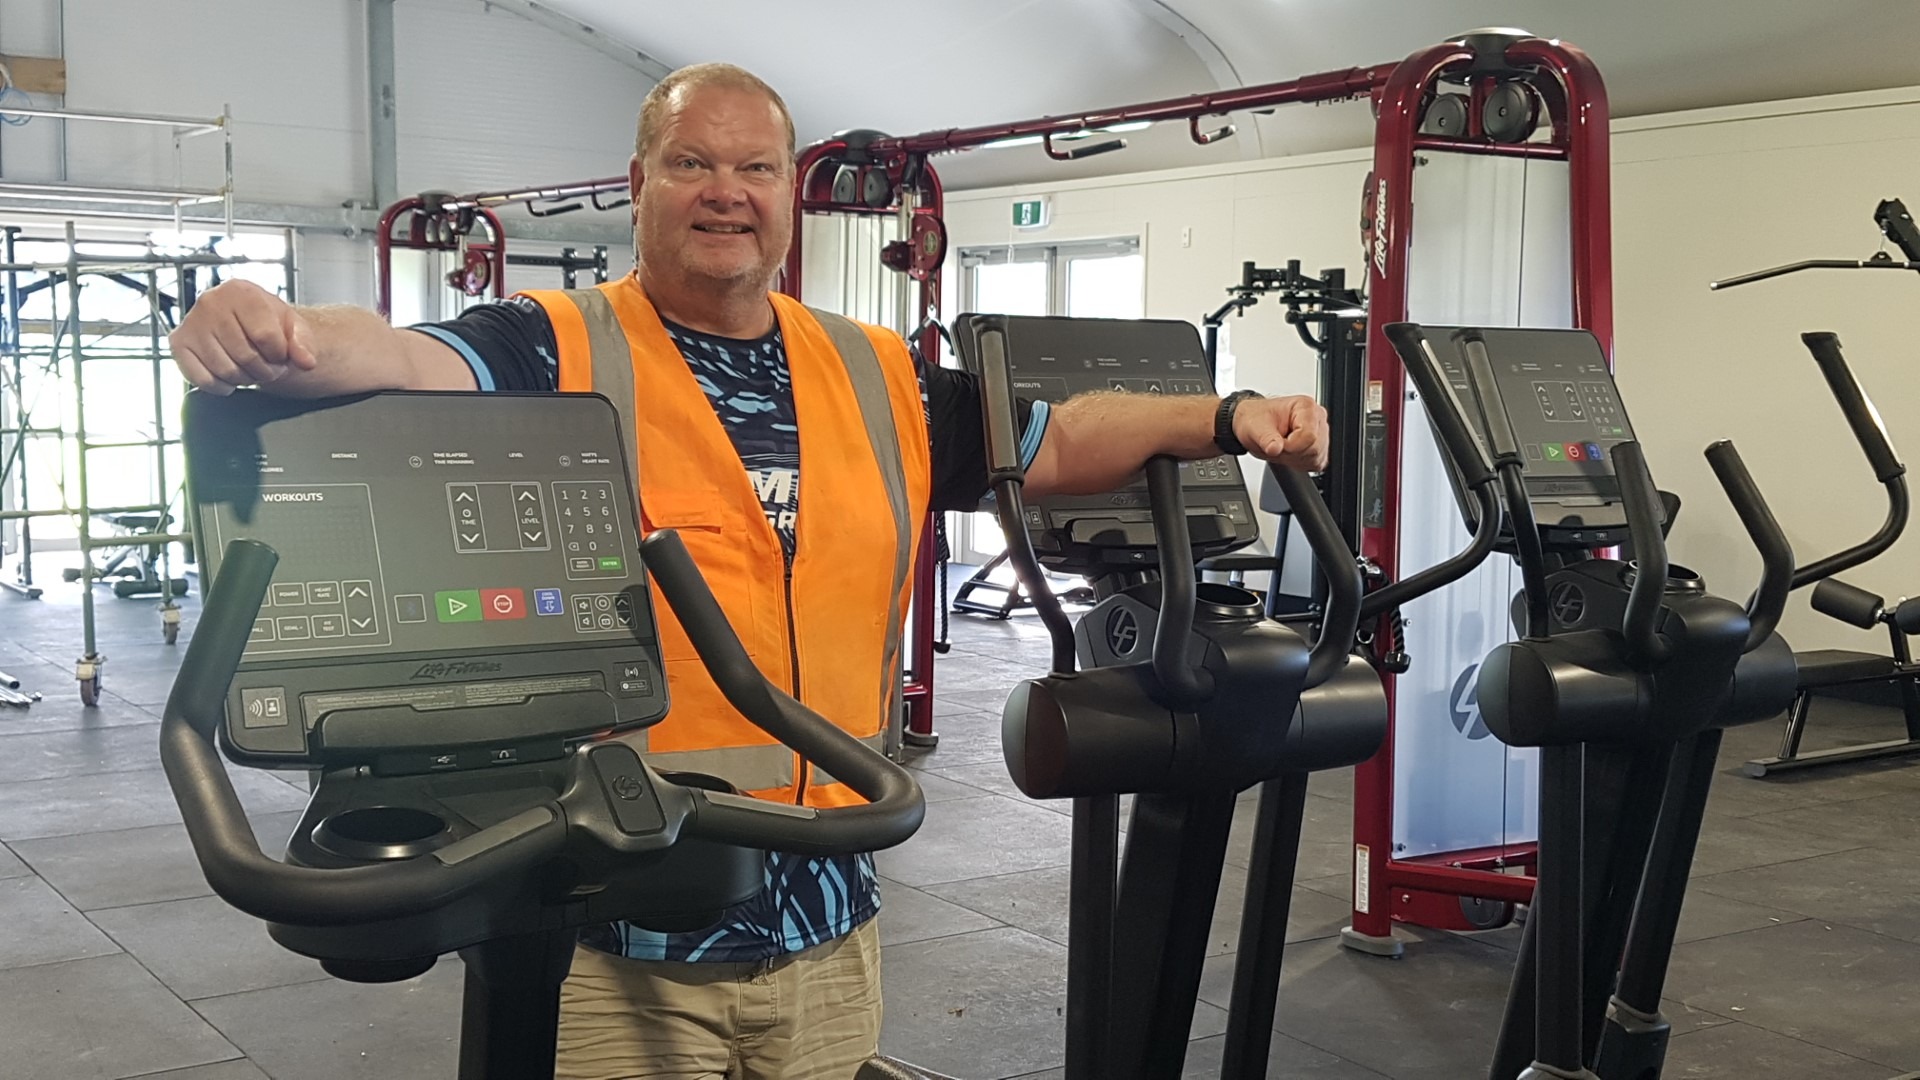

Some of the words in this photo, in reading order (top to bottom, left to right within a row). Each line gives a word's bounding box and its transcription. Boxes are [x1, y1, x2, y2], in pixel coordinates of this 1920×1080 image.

[745, 470, 799, 503] M
[262, 492, 324, 502] WORKOUTS
[562, 490, 569, 500] 1
[580, 489, 589, 500] 2
[599, 489, 607, 500] 3
[564, 507, 572, 517] 4
[583, 506, 591, 517] 5
[601, 506, 609, 517] 6
[461, 518, 476, 526] TIME
[567, 524, 574, 534] 7
[586, 524, 594, 534] 8
[604, 523, 613, 534] 9
[588, 541, 597, 551] 0
